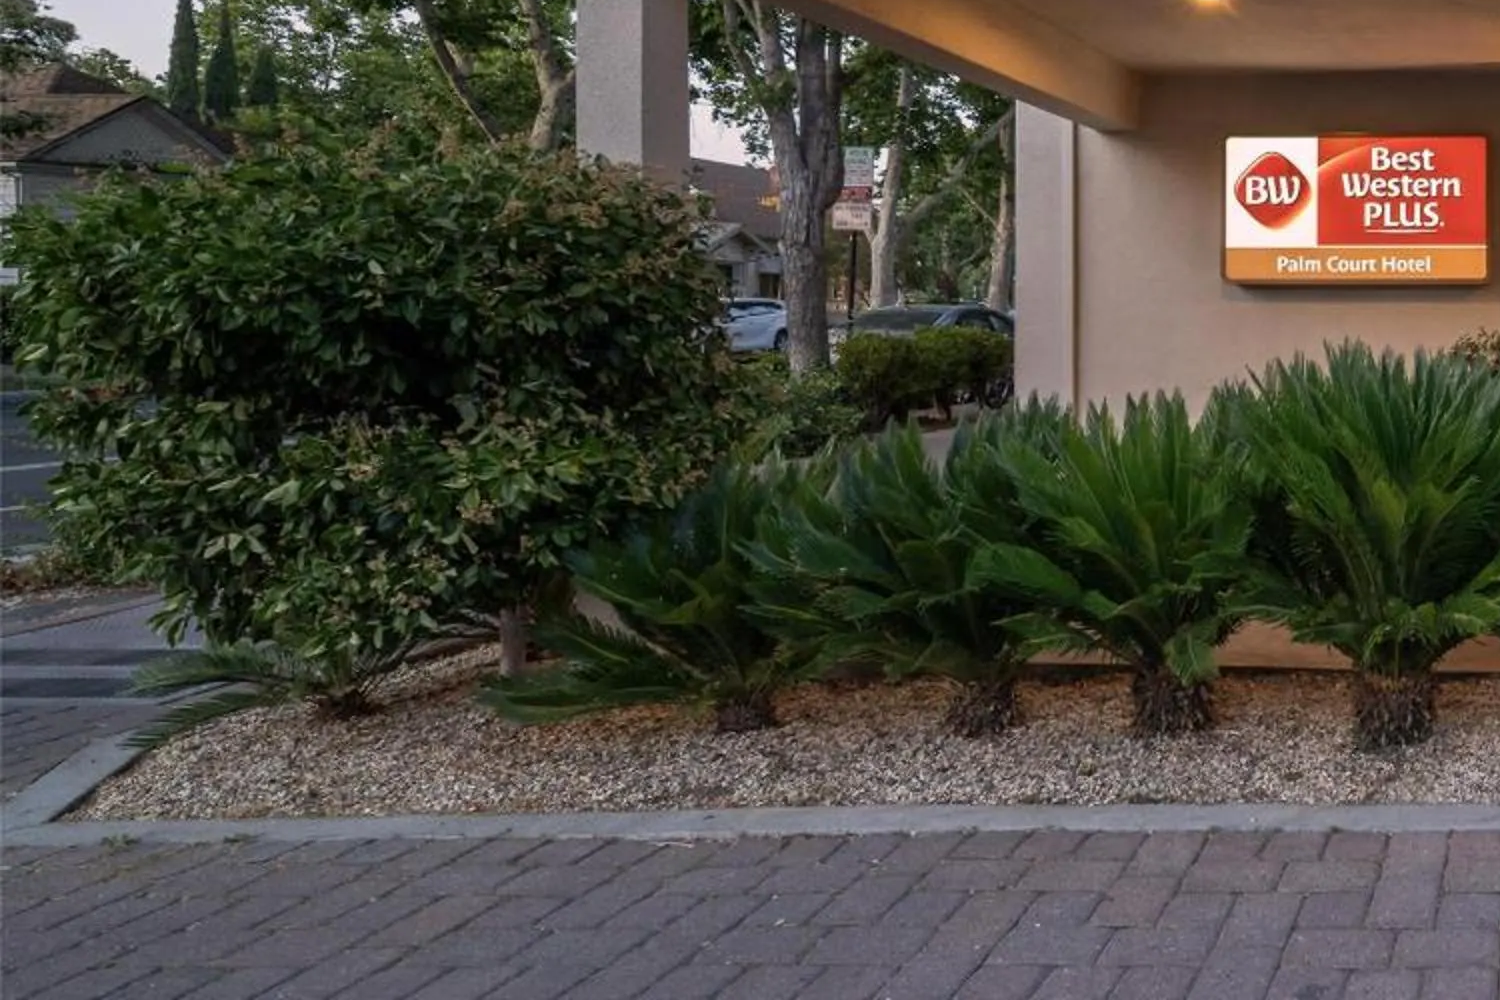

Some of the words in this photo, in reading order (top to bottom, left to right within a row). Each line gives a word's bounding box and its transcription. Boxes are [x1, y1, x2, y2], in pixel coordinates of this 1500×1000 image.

[1371, 147, 1435, 171] Best
[1245, 176, 1301, 205] BW
[1342, 173, 1462, 197] Western
[1276, 255, 1321, 273] Palm
[1327, 255, 1376, 273] Court
[1381, 255, 1431, 273] Hotel
